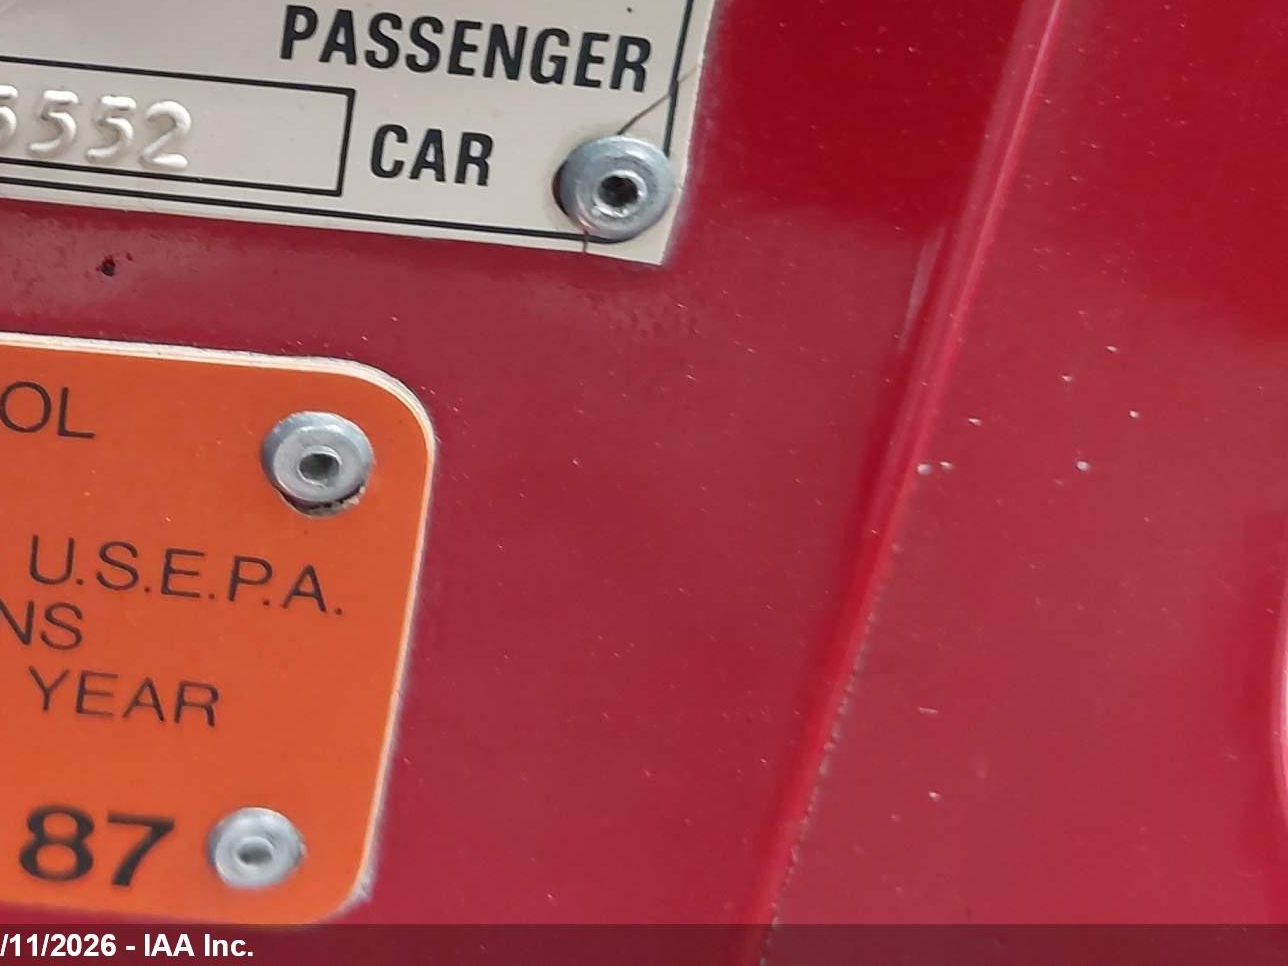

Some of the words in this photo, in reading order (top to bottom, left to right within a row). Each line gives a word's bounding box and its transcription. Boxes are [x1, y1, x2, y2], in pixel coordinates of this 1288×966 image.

[280, 4, 653, 93] PASSENGER
[370, 122, 494, 187] CAR
[28, 534, 344, 616] U.S.E.P.A.
[28, 665, 221, 728] YEAR
